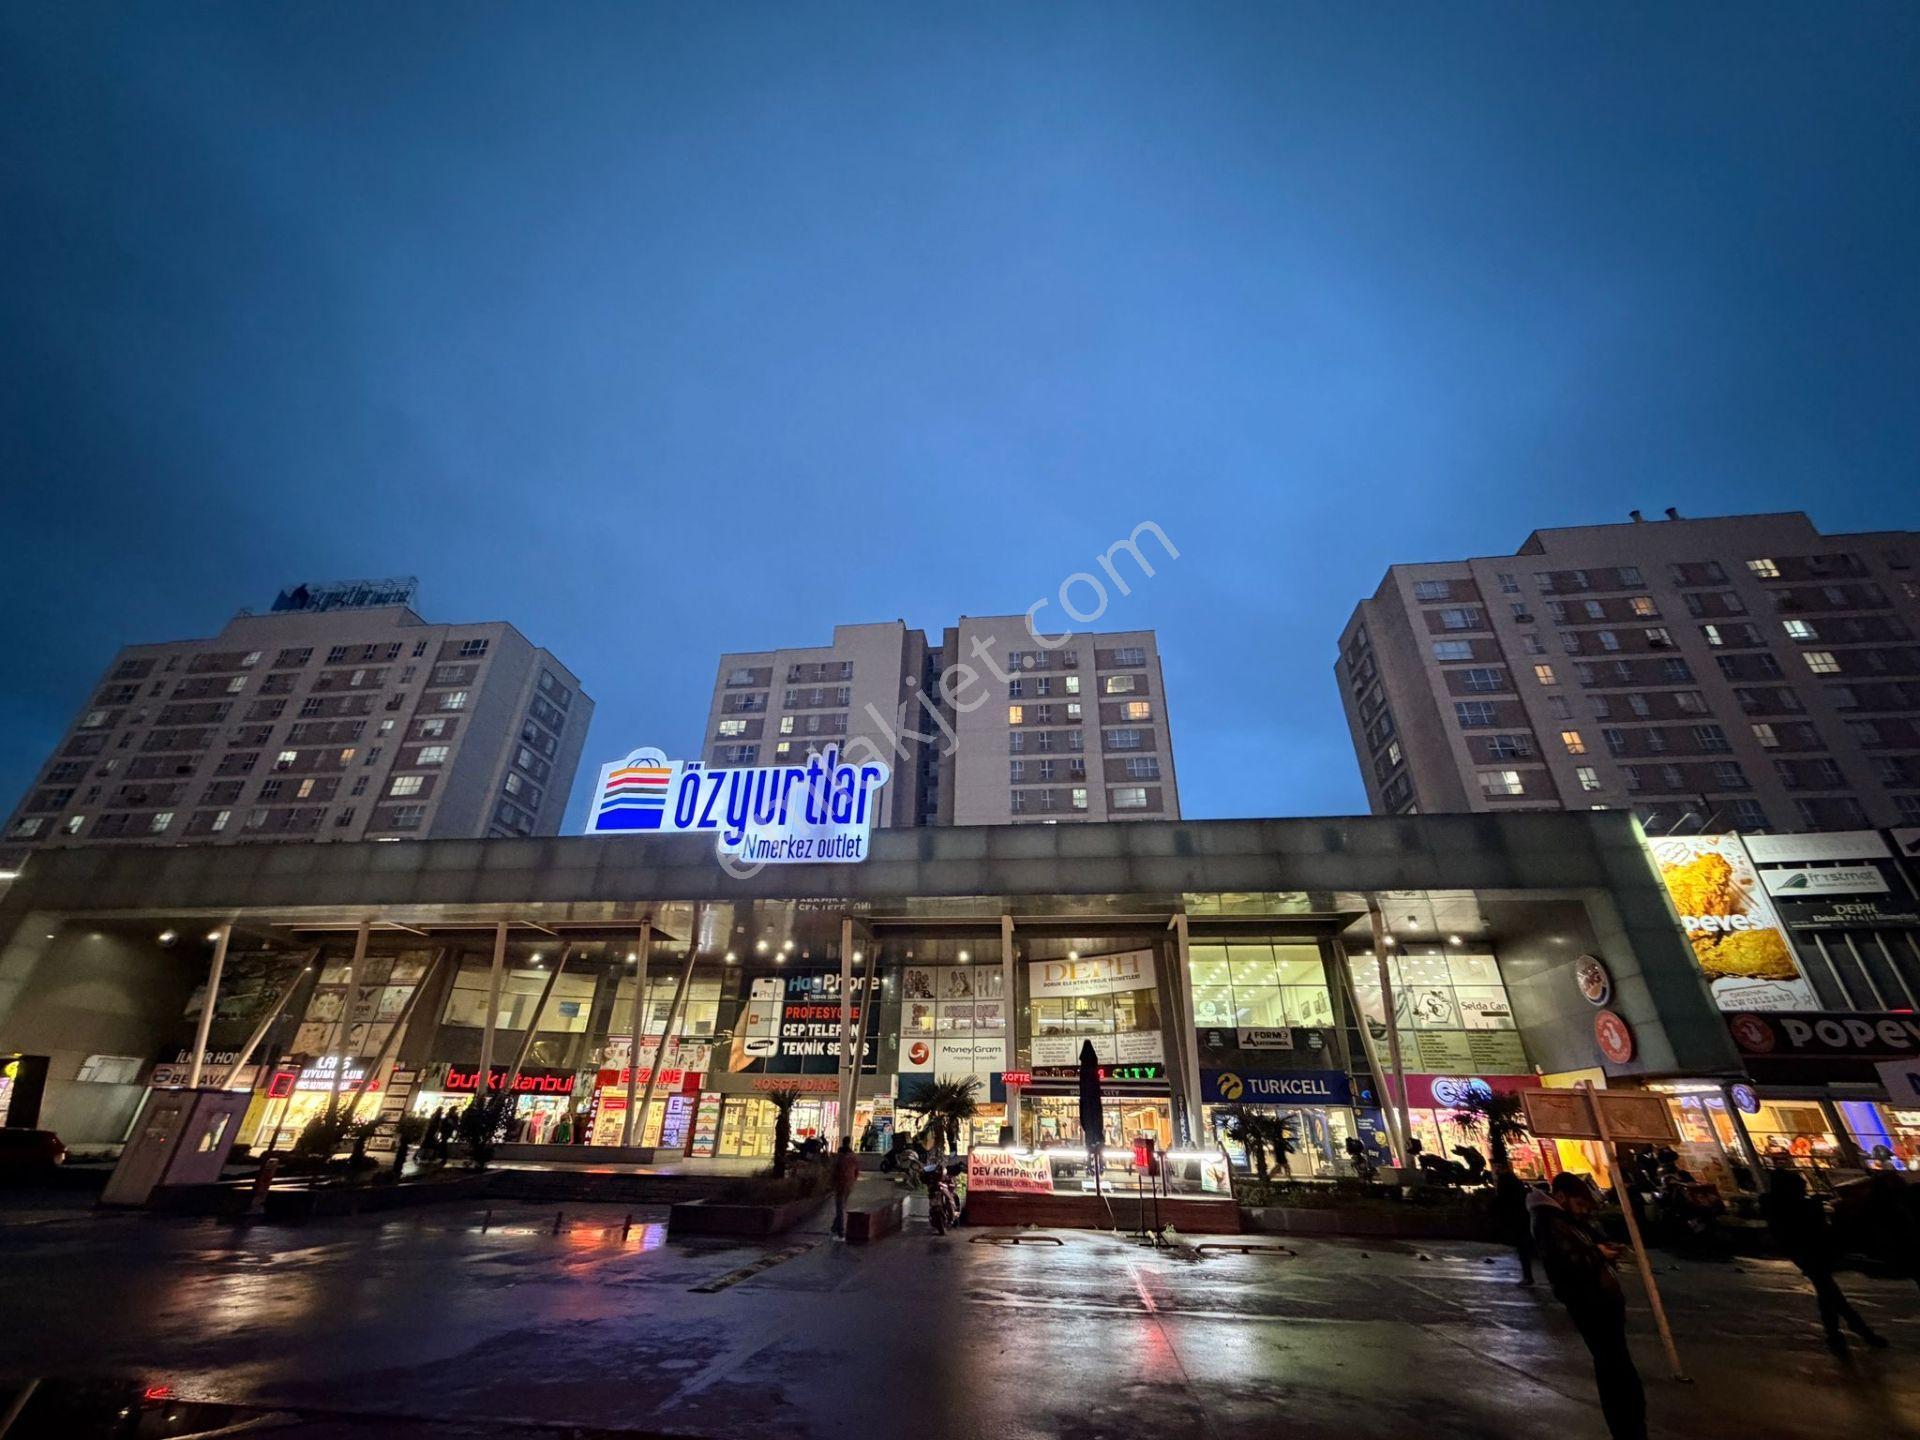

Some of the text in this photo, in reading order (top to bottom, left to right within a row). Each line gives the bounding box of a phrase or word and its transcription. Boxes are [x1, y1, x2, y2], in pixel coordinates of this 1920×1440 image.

[674, 750, 881, 846] özyurtlar
[817, 832, 863, 858] outlet
[1043, 954, 1139, 981] DEPH
[785, 1006, 861, 1019] PROFESYOE
[1489, 1001, 1509, 1010] Can
[782, 1024, 860, 1036] CEP TELEFN
[782, 1039, 869, 1055] TEKNİK SEVS
[446, 1068, 575, 1092] butk itanbul
[621, 1067, 682, 1084] EZNE
[1248, 1079, 1331, 1095] TURKCELL
[972, 1167, 1047, 1180] DEV KAMPANYA!
